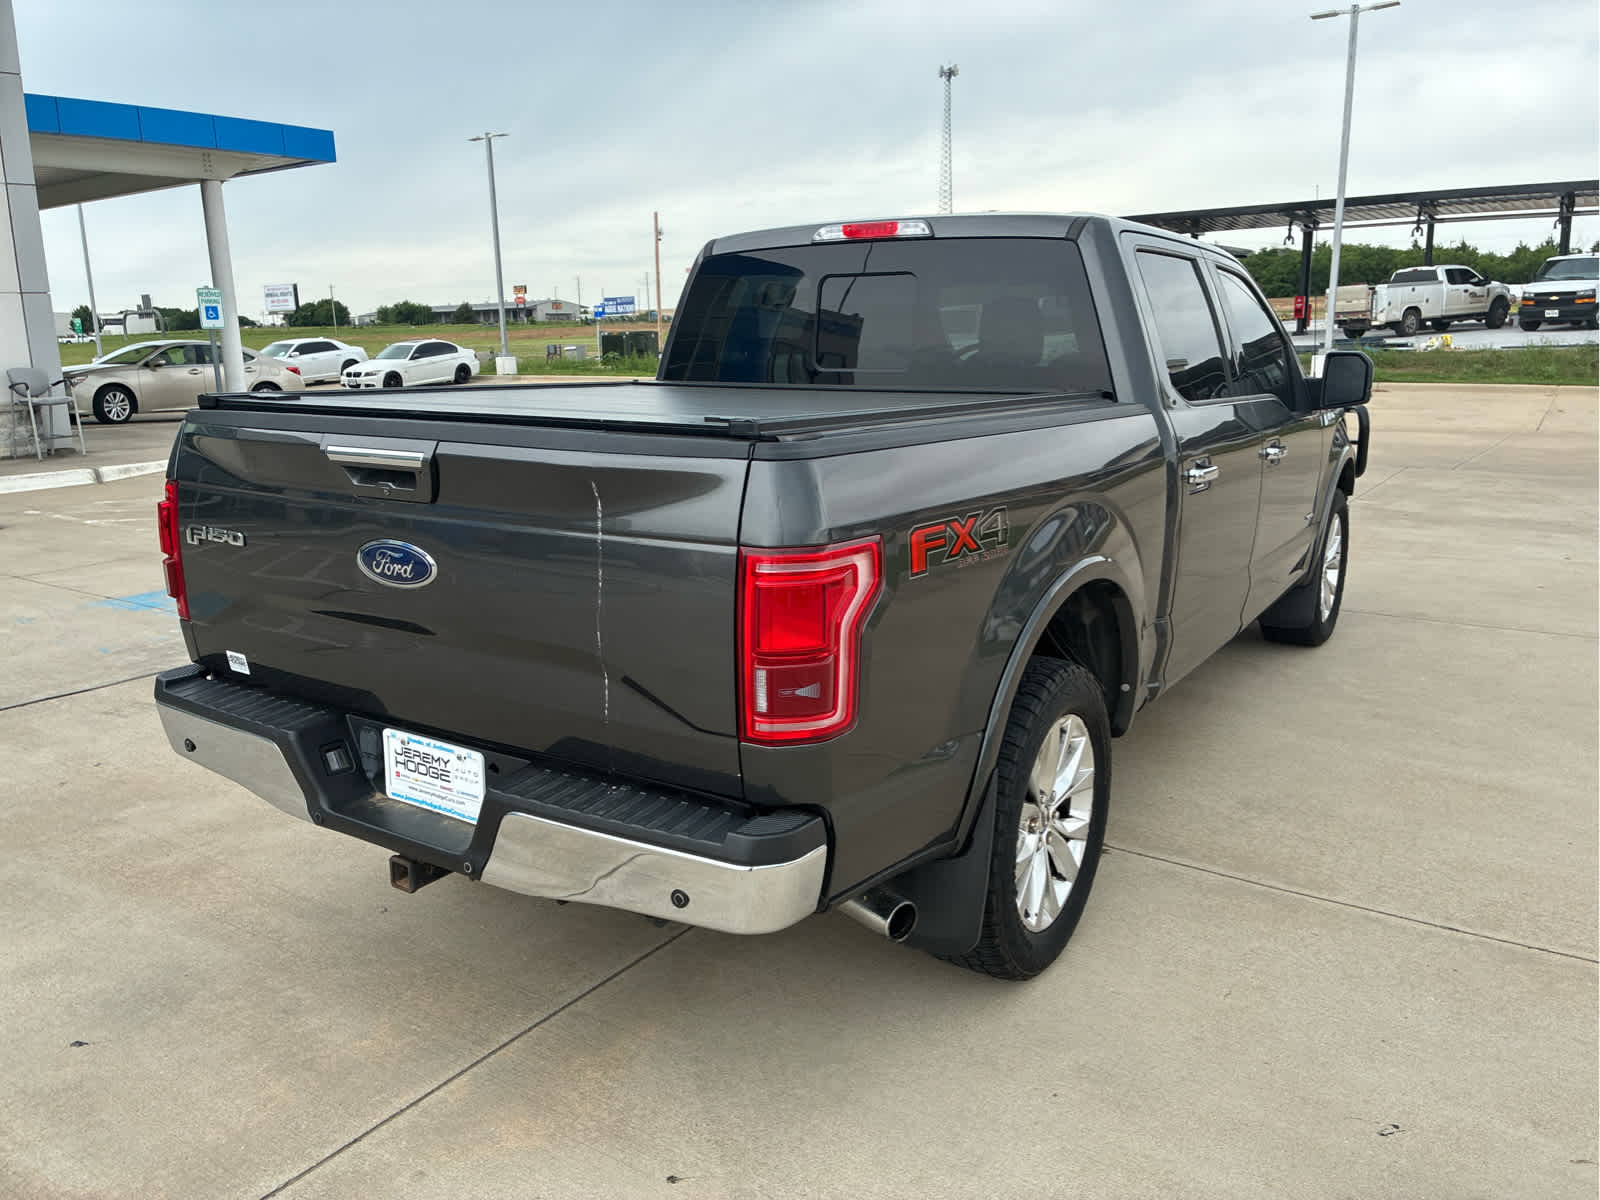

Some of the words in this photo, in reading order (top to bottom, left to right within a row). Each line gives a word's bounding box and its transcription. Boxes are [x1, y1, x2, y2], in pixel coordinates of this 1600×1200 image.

[908, 505, 1009, 580] FX4
[372, 549, 415, 579] Ford
[394, 746, 450, 768] JEREMY
[394, 756, 452, 783] HODGE
